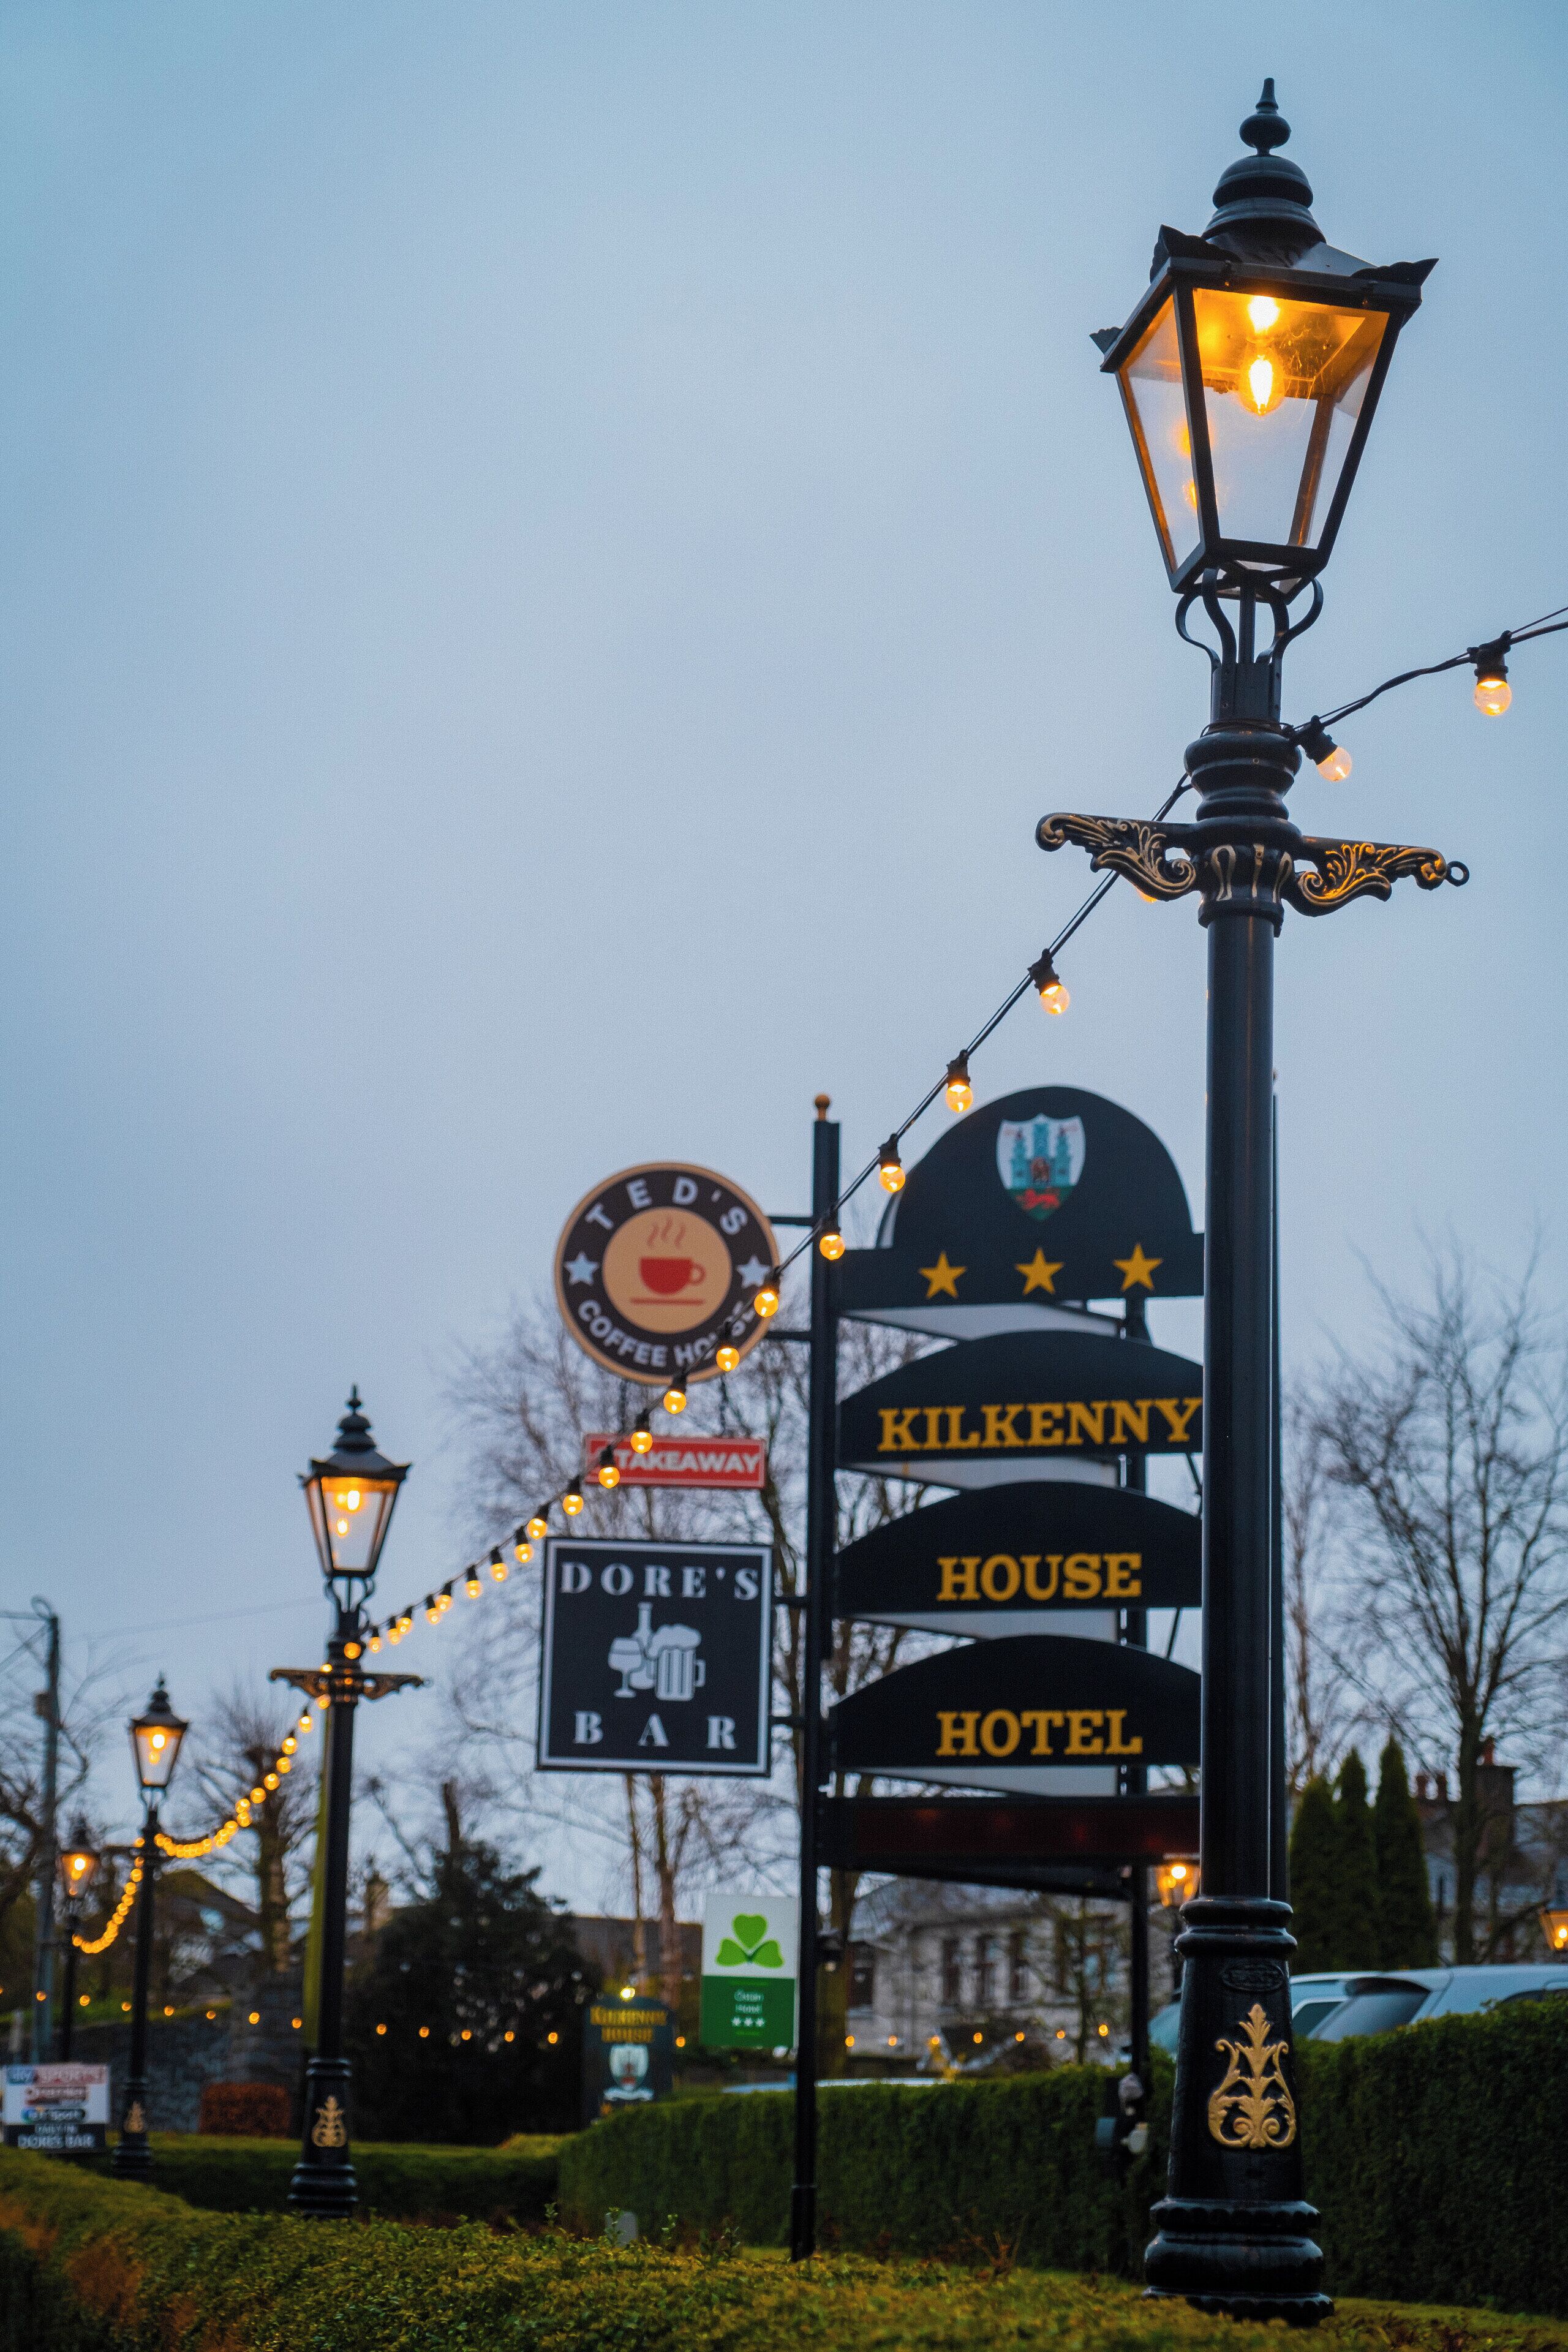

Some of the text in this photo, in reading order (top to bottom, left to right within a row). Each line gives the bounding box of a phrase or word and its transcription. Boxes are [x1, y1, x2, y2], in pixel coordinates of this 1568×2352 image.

[586, 1177, 747, 1235] TED'S
[578, 1300, 668, 1367] COFFEE
[878, 1397, 1203, 1452] KILKENNY
[613, 1449, 760, 1473] TAKEAWAY
[560, 1561, 759, 1600] DORE'S
[937, 1553, 1142, 1601] HOUSE
[573, 1710, 737, 1750] BAR
[936, 1709, 1143, 1757] HOTEL
[66, 2134, 94, 2148] BAR
